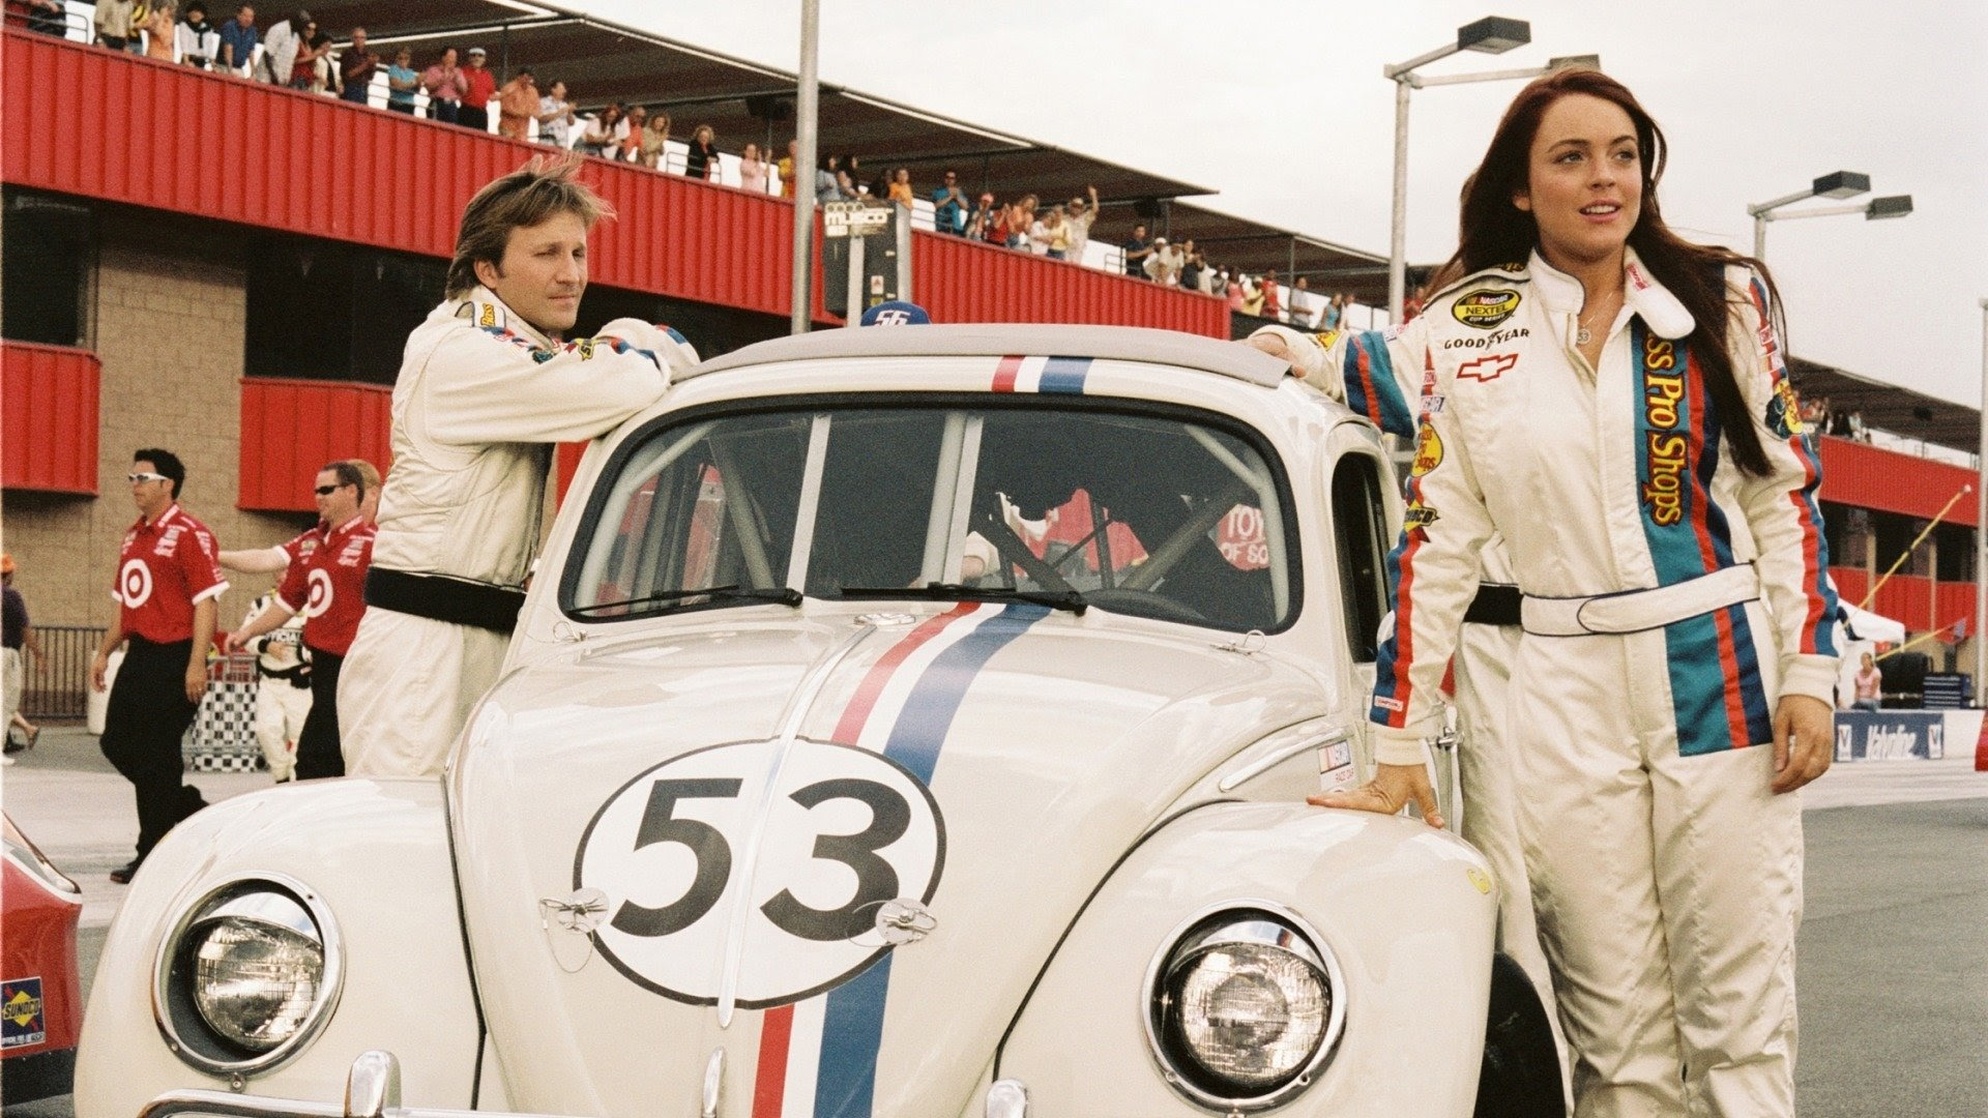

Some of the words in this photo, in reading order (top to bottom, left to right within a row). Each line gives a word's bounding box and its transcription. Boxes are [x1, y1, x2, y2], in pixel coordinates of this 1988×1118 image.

[1465, 304, 1507, 315] NEXTEL
[1444, 328, 1530, 350] GOODYEAR
[1647, 374, 1684, 428] Pro
[1644, 434, 1687, 525] Shops
[610, 777, 911, 941] 53
[4, 1000, 40, 1018] SUNOCO
